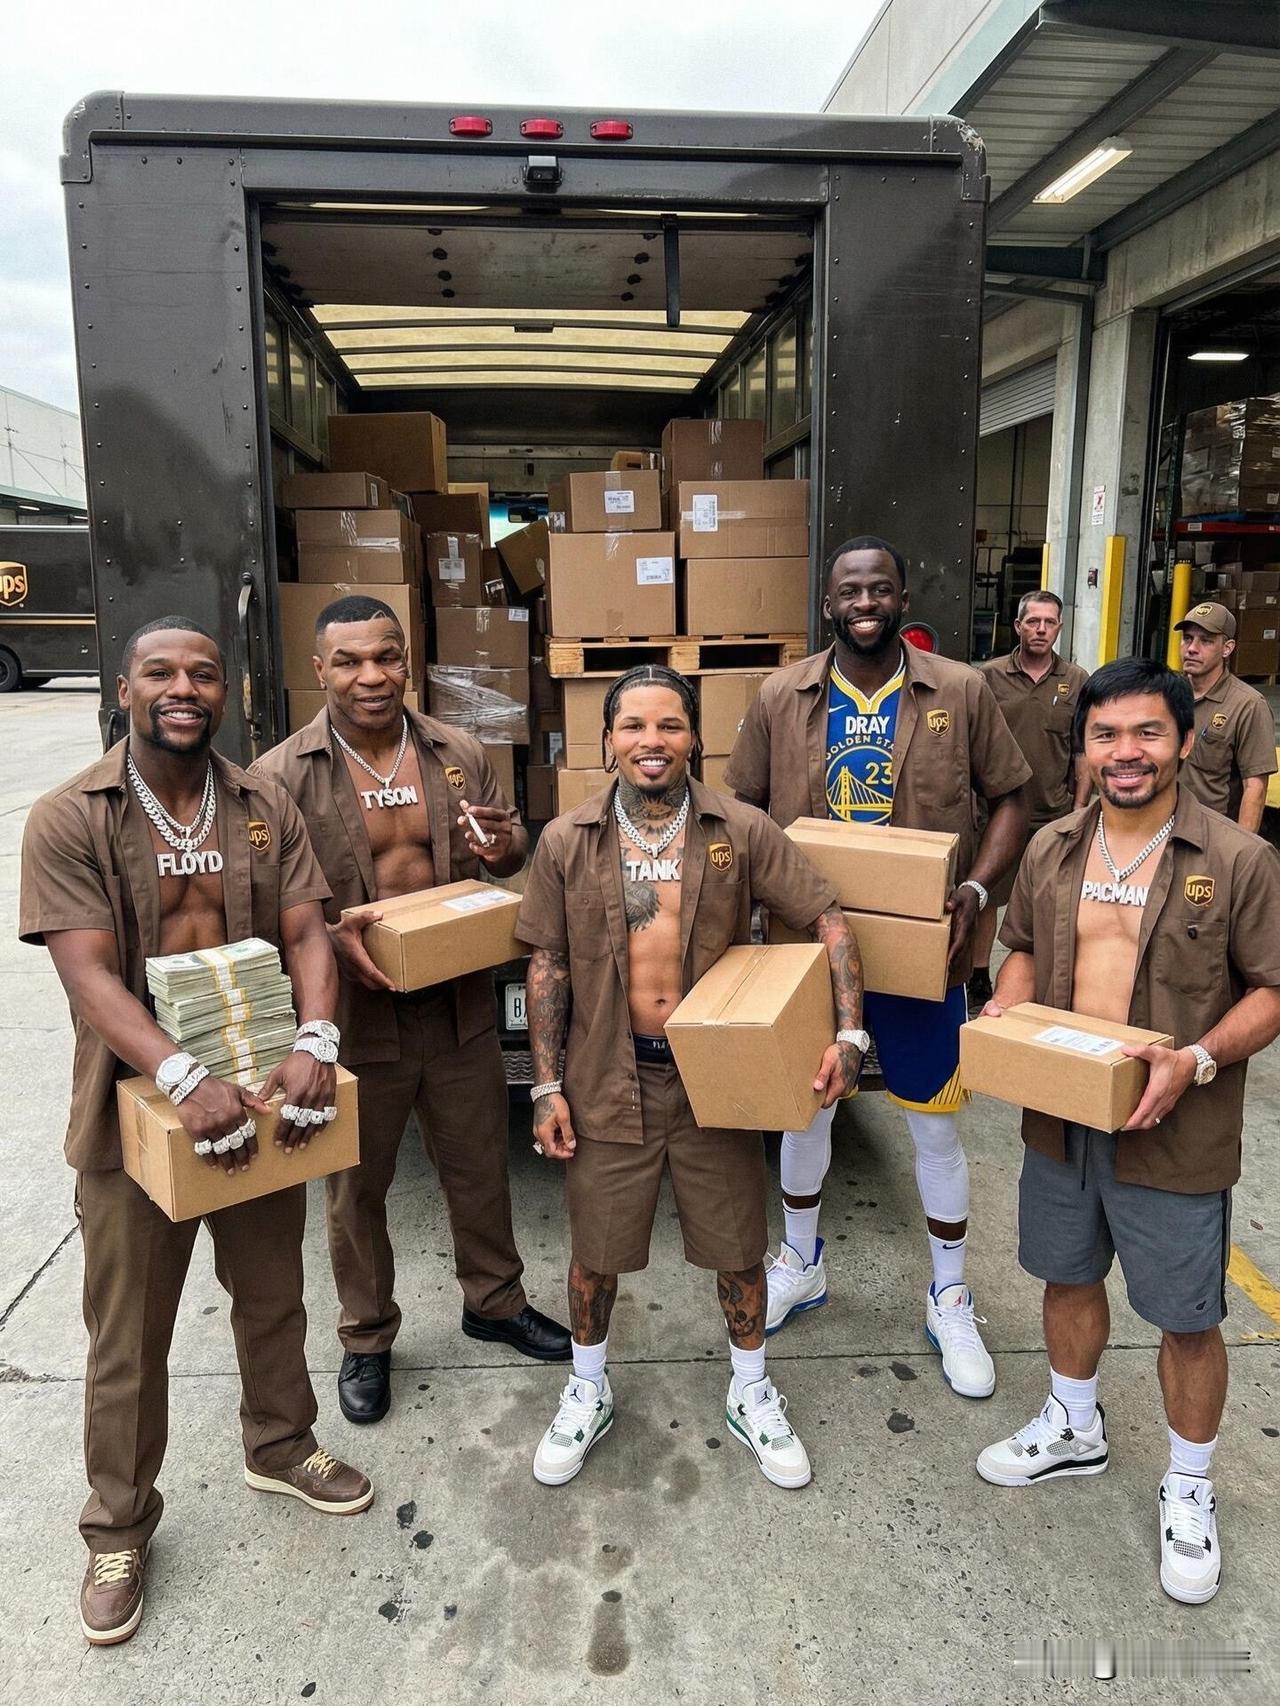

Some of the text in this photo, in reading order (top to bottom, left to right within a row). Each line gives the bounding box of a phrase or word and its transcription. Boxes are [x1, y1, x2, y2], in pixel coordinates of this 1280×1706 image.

[0, 575, 25, 599] ps
[845, 716, 890, 735] DRAY
[929, 717, 948, 732] ups
[865, 761, 893, 785] 23
[360, 785, 418, 809] TYSON
[156, 850, 224, 877] FLOYD
[626, 859, 680, 881] TANK
[711, 851, 730, 867] ups
[1080, 880, 1149, 907] PACMAN
[1186, 884, 1213, 902] ups
